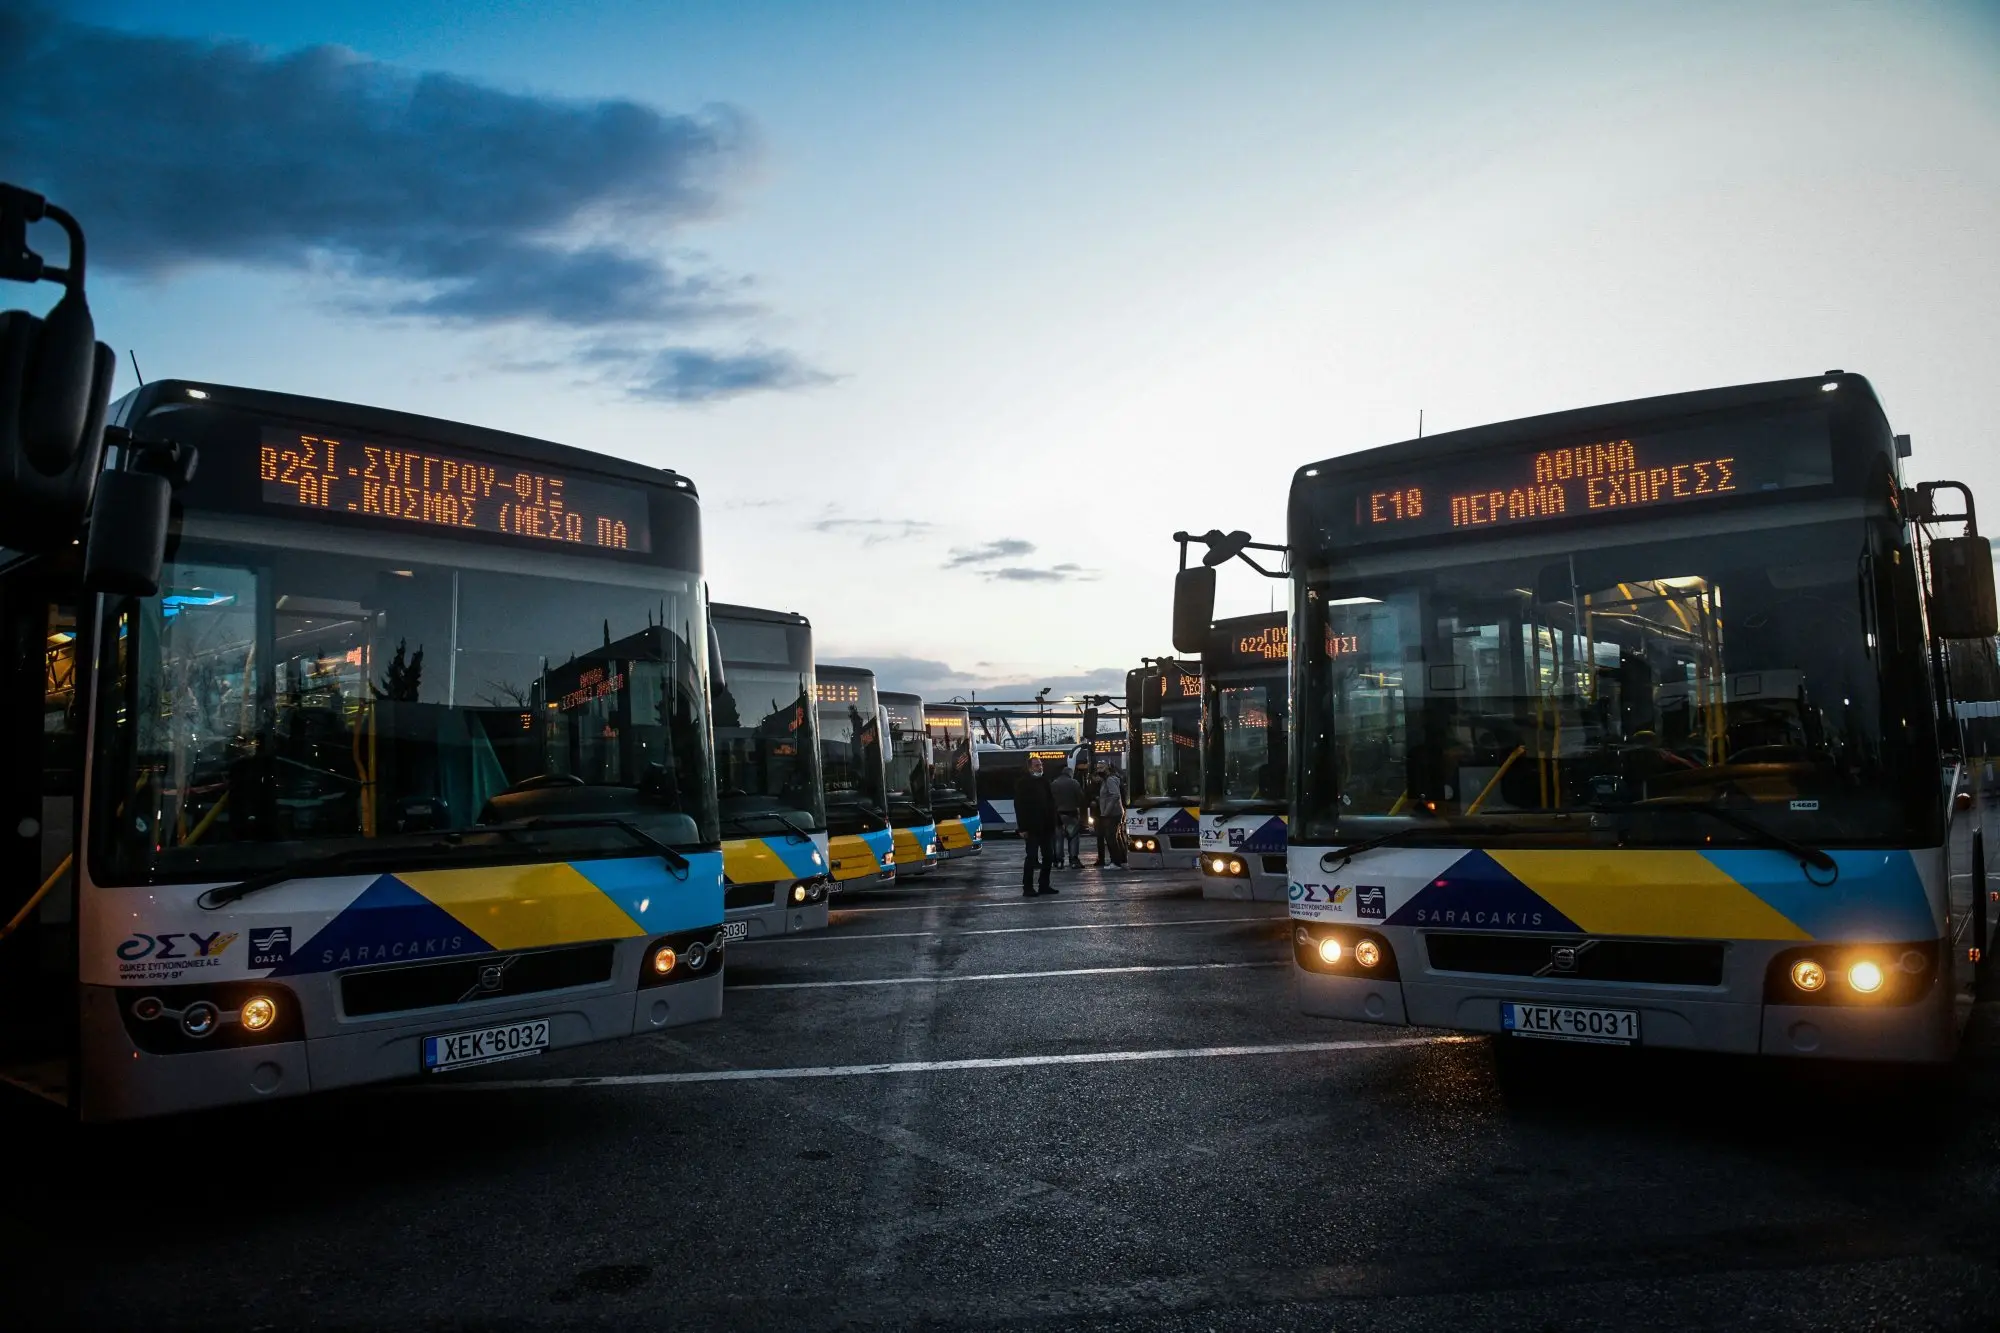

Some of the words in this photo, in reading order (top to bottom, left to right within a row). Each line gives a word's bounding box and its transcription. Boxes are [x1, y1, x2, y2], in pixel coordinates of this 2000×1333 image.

[1536, 440, 1636, 483] ΑΘΗΝΑ
[1452, 484, 1565, 527] ΠΕΡΑΜΑ
[1588, 458, 1736, 508] ΕΧΠΡΕΣΣ
[500, 503, 582, 542] (ΜΕΣΩ
[598, 517, 628, 549] ΠΑ
[1264, 627, 1288, 642] ΓΟΥ
[1241, 636, 1264, 652] 622
[1417, 909, 1543, 926] SARACAKIS
[322, 936, 462, 964] SARACAKIS
[254, 954, 284, 964] ΟΑΣΑ
[120, 970, 184, 980] www.osy.gr
